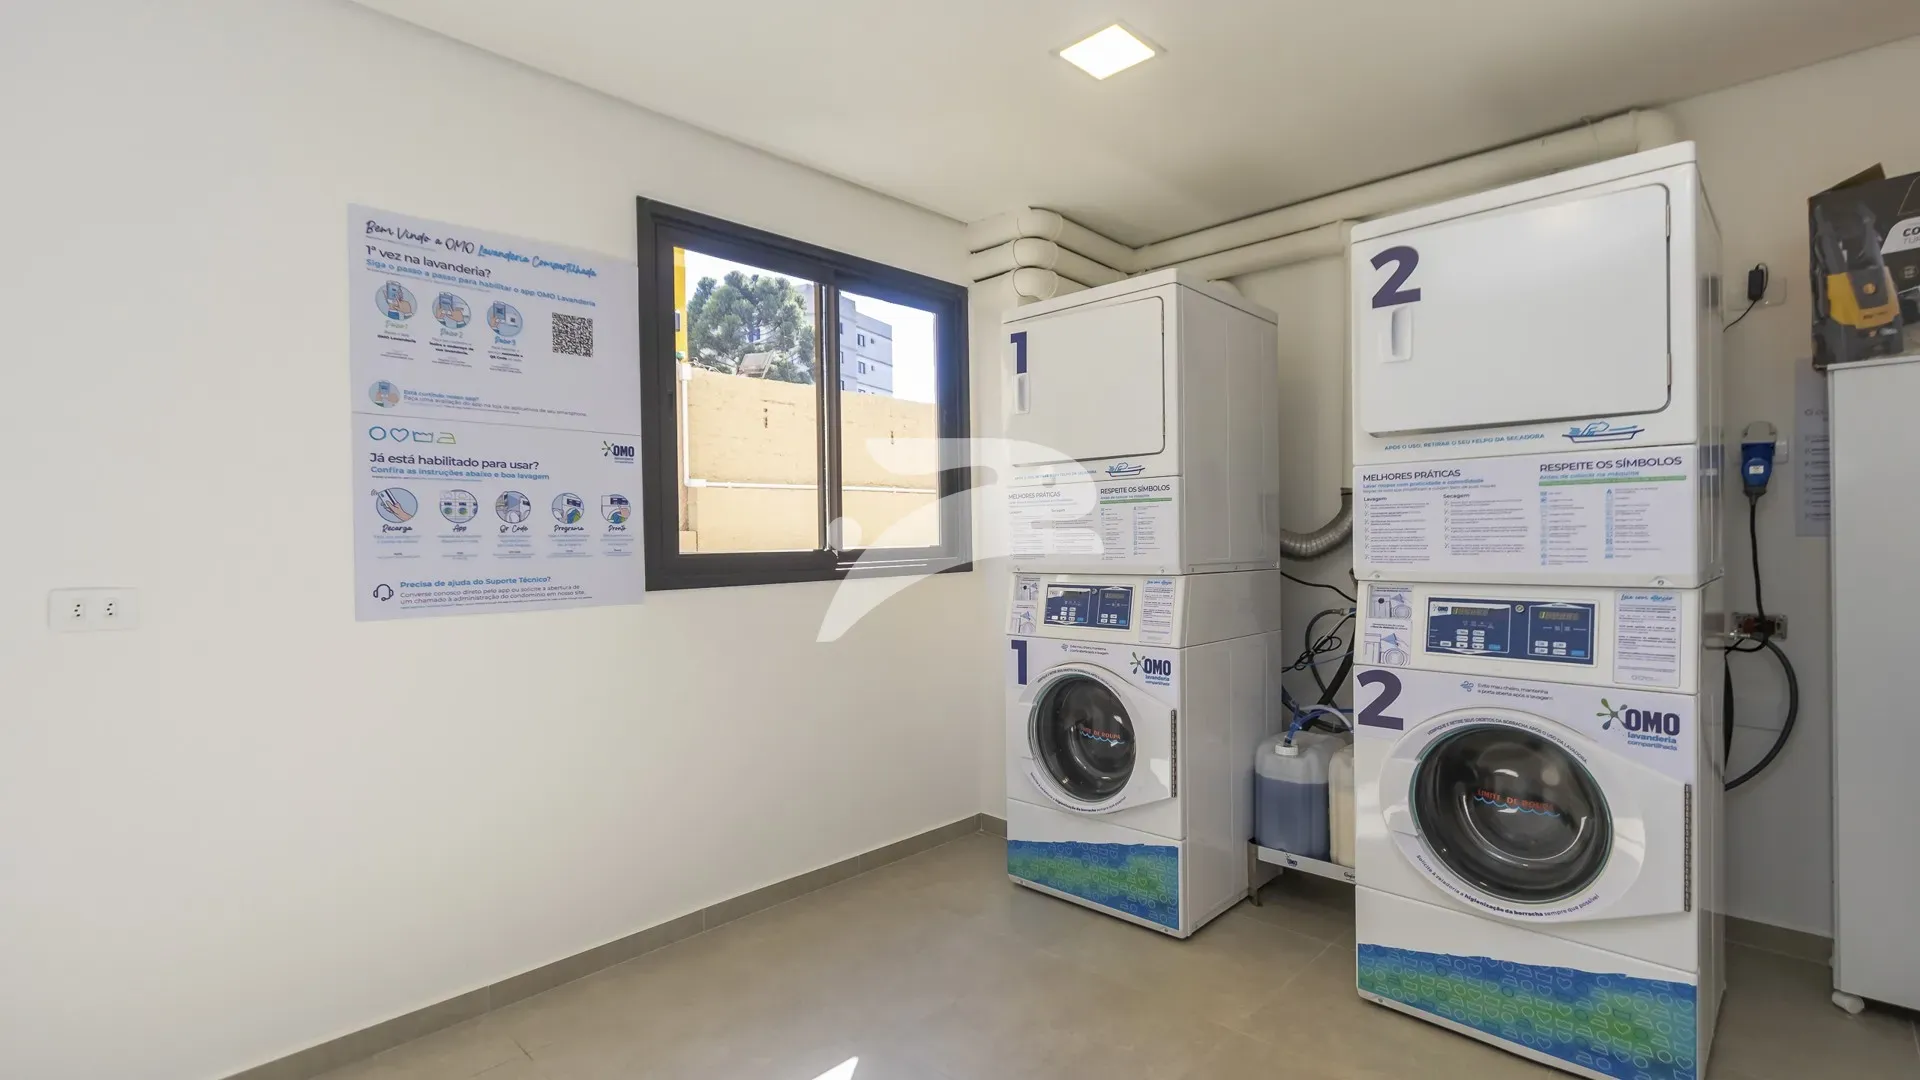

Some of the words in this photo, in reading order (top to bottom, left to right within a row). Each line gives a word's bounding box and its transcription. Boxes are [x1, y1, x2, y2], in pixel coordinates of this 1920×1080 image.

[366, 220, 394, 236] Bem
[397, 228, 431, 244] Vindo
[445, 237, 475, 254] OMO
[379, 249, 402, 260] vez
[405, 254, 420, 265] na
[424, 256, 492, 278] lavanderia?
[366, 259, 386, 270] Siga
[397, 265, 423, 276] passo
[432, 272, 457, 282] passo
[459, 276, 477, 286] para
[479, 280, 512, 292] habilitar
[521, 288, 536, 297] app
[536, 291, 556, 300] OMO
[558, 294, 596, 307] Lavanderia
[1370, 245, 1421, 309] 2
[1010, 331, 1028, 374] 1
[1506, 433, 1545, 442] SECADORA
[614, 445, 635, 457] OMO
[370, 452, 385, 463] Já
[388, 454, 415, 464] está
[418, 455, 480, 467] habilitado
[482, 459, 507, 470] para
[510, 461, 540, 470] usar?
[1540, 462, 1594, 472] RESPEITE
[1596, 461, 1613, 469] OS
[1616, 456, 1682, 468] SÍMBOLOS
[370, 466, 404, 474] Confira
[418, 468, 464, 477] instruções
[466, 470, 492, 478] abaixo
[500, 471, 516, 479] boa
[518, 472, 550, 480] lavagem
[1363, 472, 1412, 482] MELHORES
[1414, 469, 1460, 479] PRÁTICAS
[1008, 492, 1036, 500] MELHORES
[1100, 486, 1128, 494] RESPEITE
[1138, 484, 1170, 492] SÍMBOLOS
[382, 524, 413, 533] Recarga
[452, 524, 467, 532] App
[500, 524, 509, 533] Qr
[512, 524, 528, 533] Code
[554, 524, 584, 533] Programa
[608, 524, 627, 532] Pronto
[447, 580, 471, 588] ajuda
[486, 577, 517, 586] Suporte
[519, 576, 551, 584] Técnico?
[414, 596, 446, 604] chamado
[454, 593, 500, 602] administração
[510, 590, 546, 599] condomínio
[463, 588, 482, 596] direto
[483, 588, 497, 596] pelo
[547, 584, 572, 592] abertura
[1011, 640, 1028, 686] 1
[1144, 658, 1171, 676] OMO
[1146, 674, 1170, 682] lavanderia
[1356, 670, 1404, 730] 2
[1626, 708, 1680, 736] OMO
[1628, 732, 1677, 744] lavanderia
[1546, 732, 1556, 740] USO
[1557, 737, 1564, 745] DA
[1564, 742, 1588, 763] LAVADORA
[1416, 854, 1432, 872] Solicite
[1436, 874, 1460, 894] zeladoria
[1464, 894, 1504, 912] higienização
[1544, 909, 1568, 917] sempre
[1579, 894, 1600, 908] possível
